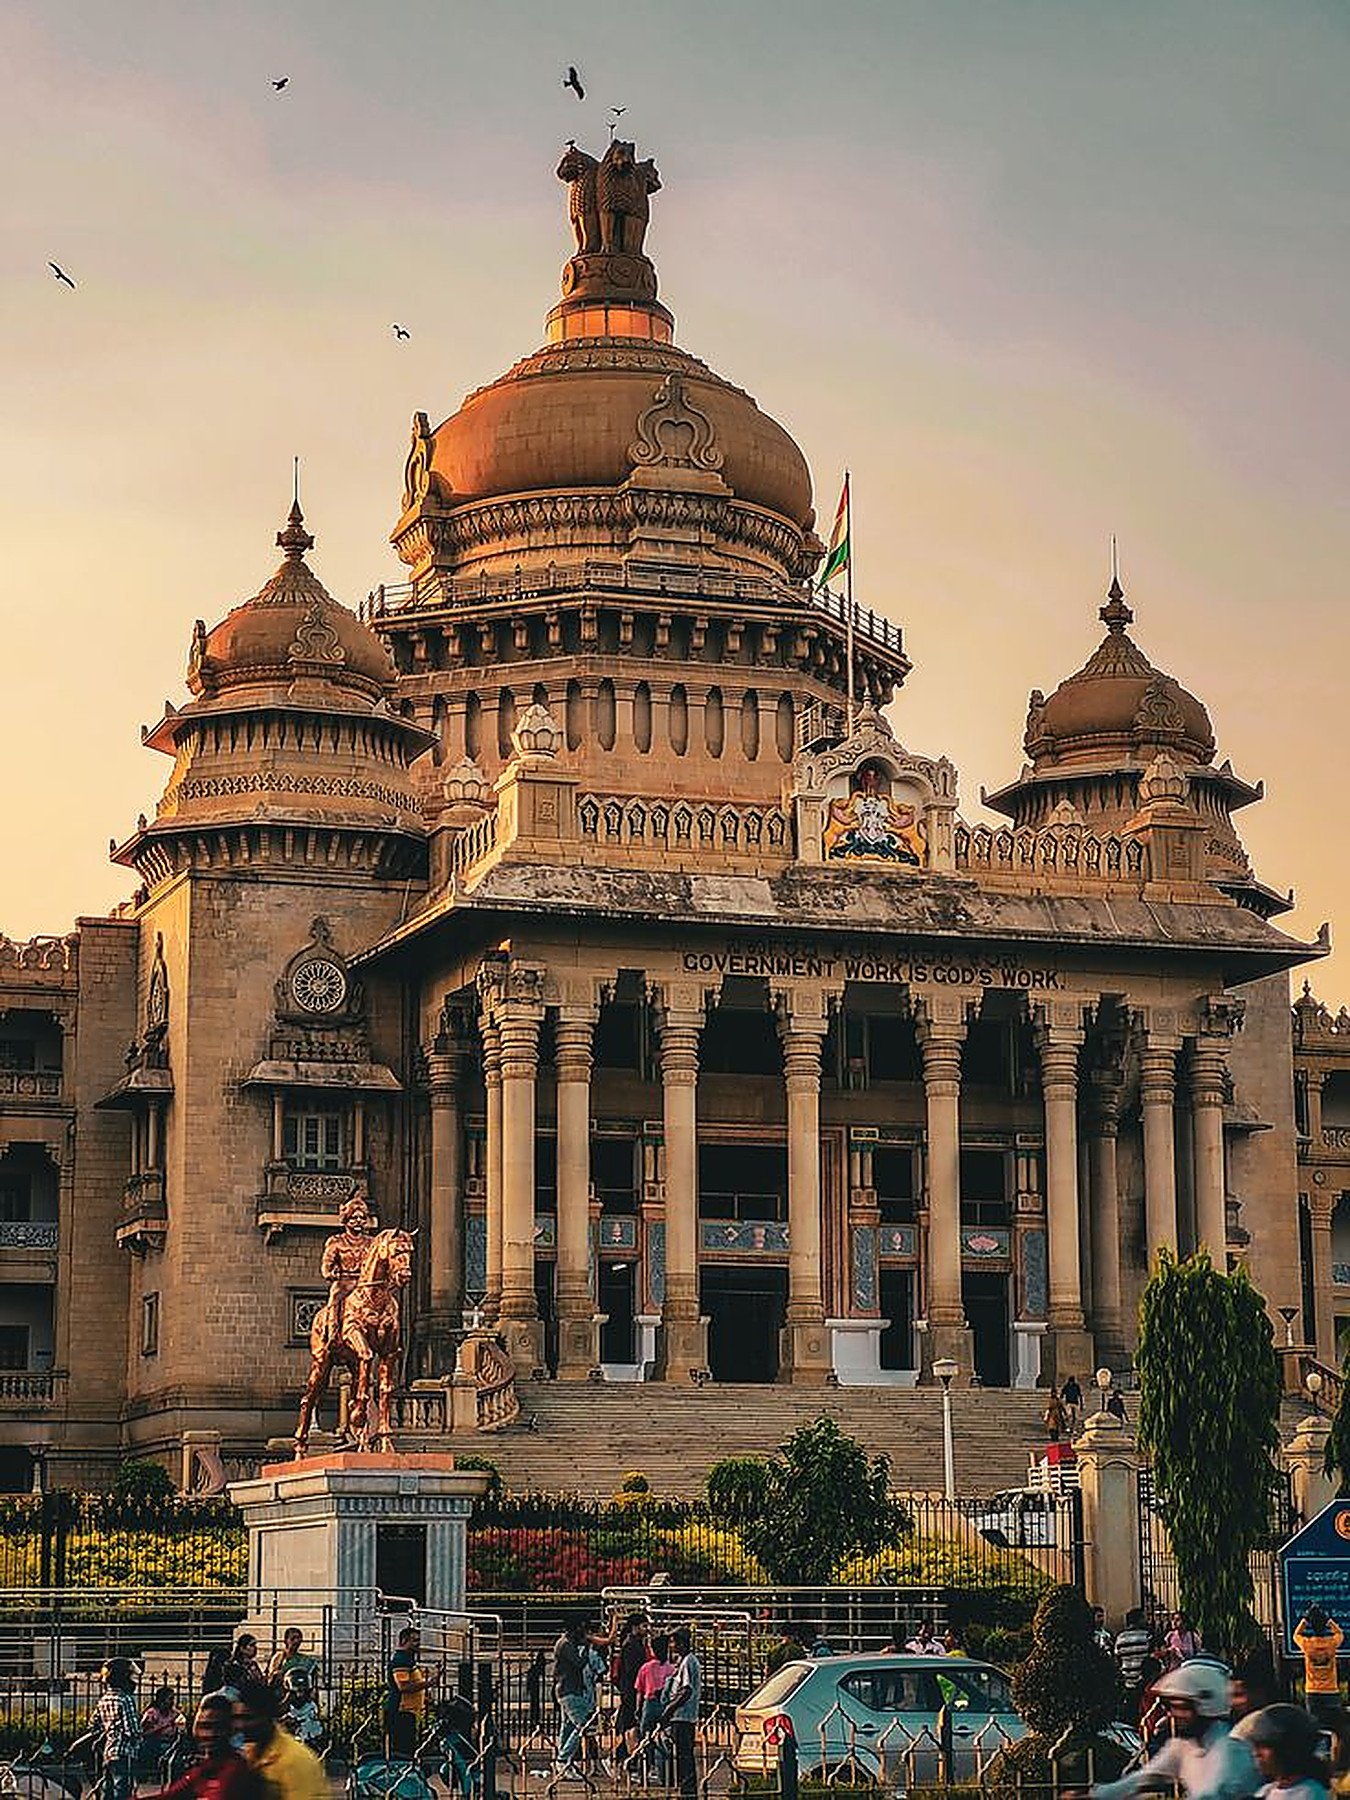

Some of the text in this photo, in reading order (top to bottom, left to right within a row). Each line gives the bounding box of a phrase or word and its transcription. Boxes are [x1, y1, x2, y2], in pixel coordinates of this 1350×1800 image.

[684, 953, 1066, 990] GOVERNMENT WORK IS GOD'S WORK.
